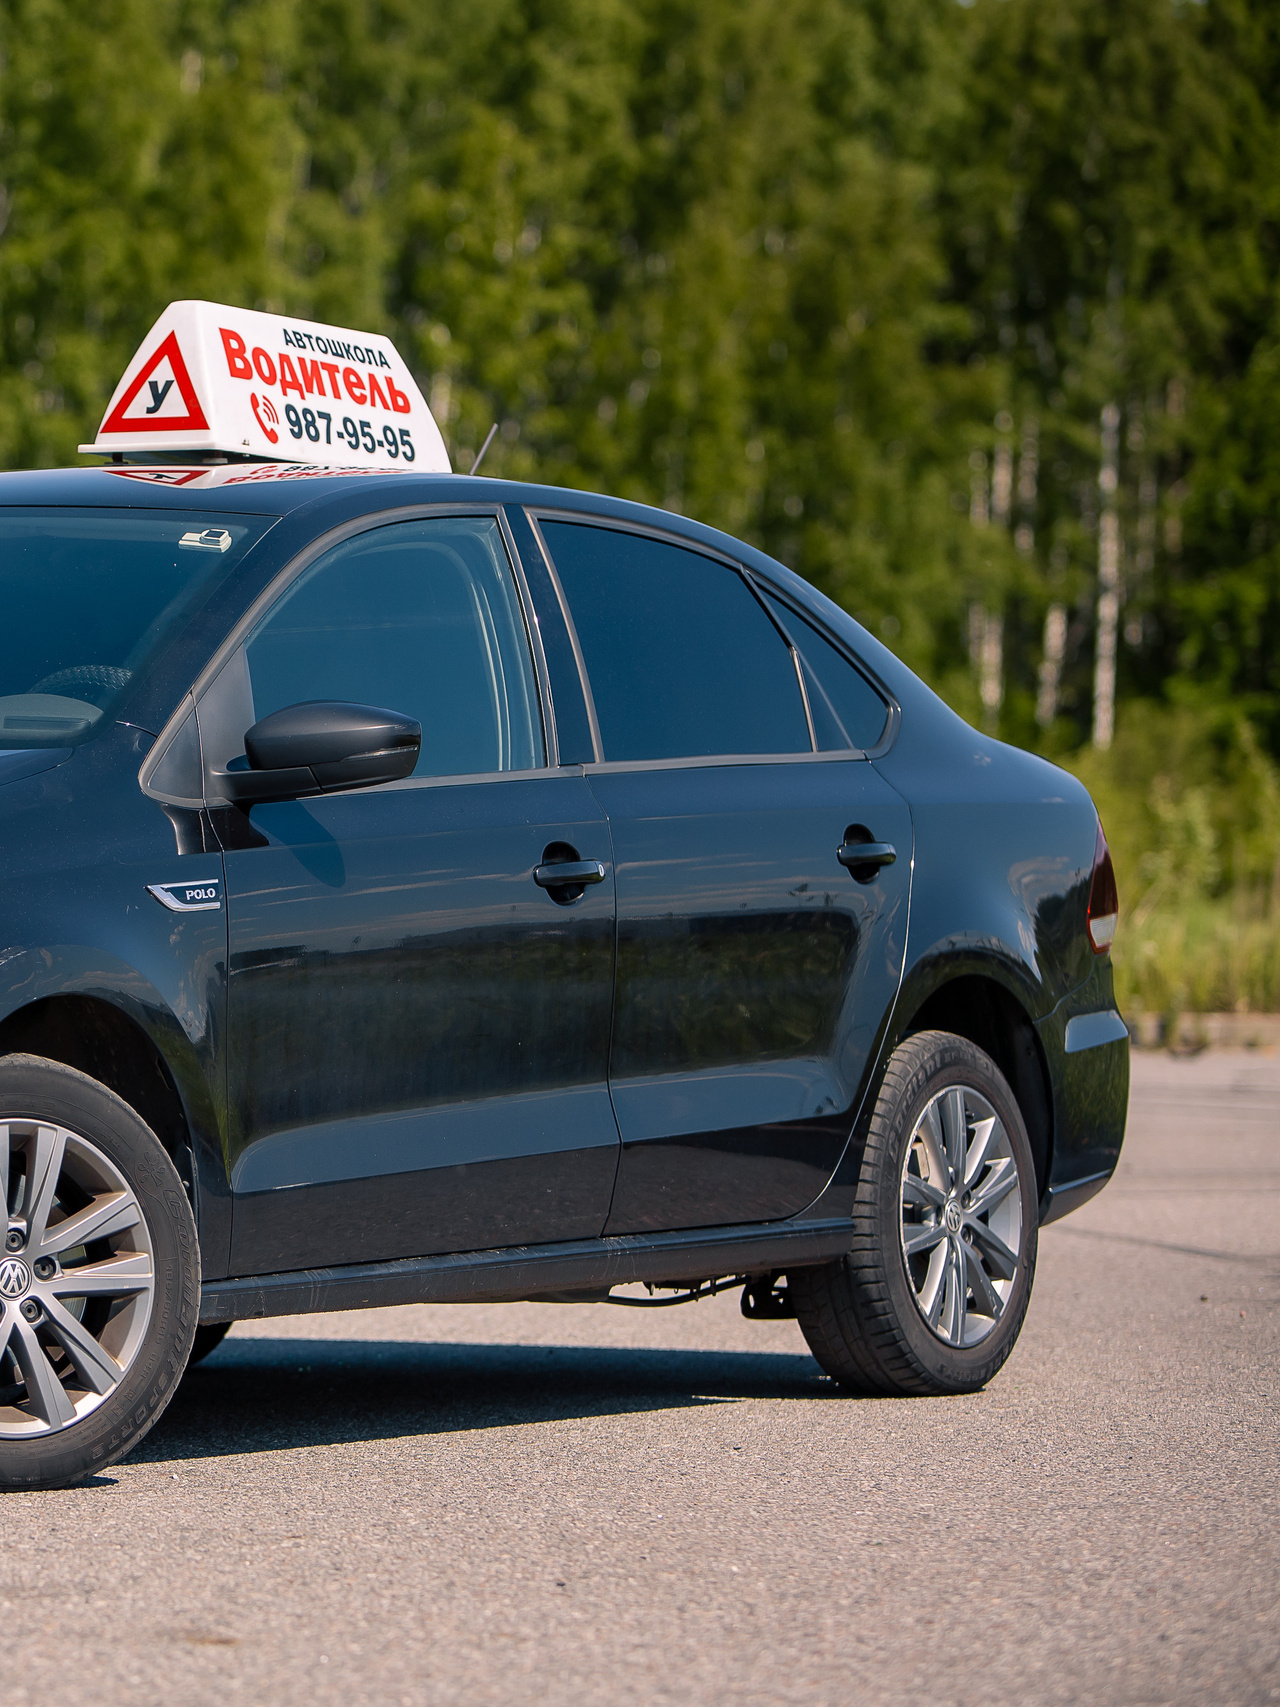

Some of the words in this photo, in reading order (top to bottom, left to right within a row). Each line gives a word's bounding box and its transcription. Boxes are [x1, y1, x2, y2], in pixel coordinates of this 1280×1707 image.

[218, 327, 412, 414] Водитель
[282, 328, 391, 369] АВТОШКОЛА
[284, 403, 416, 462] 987-95-95
[185, 888, 216, 900] POLO
